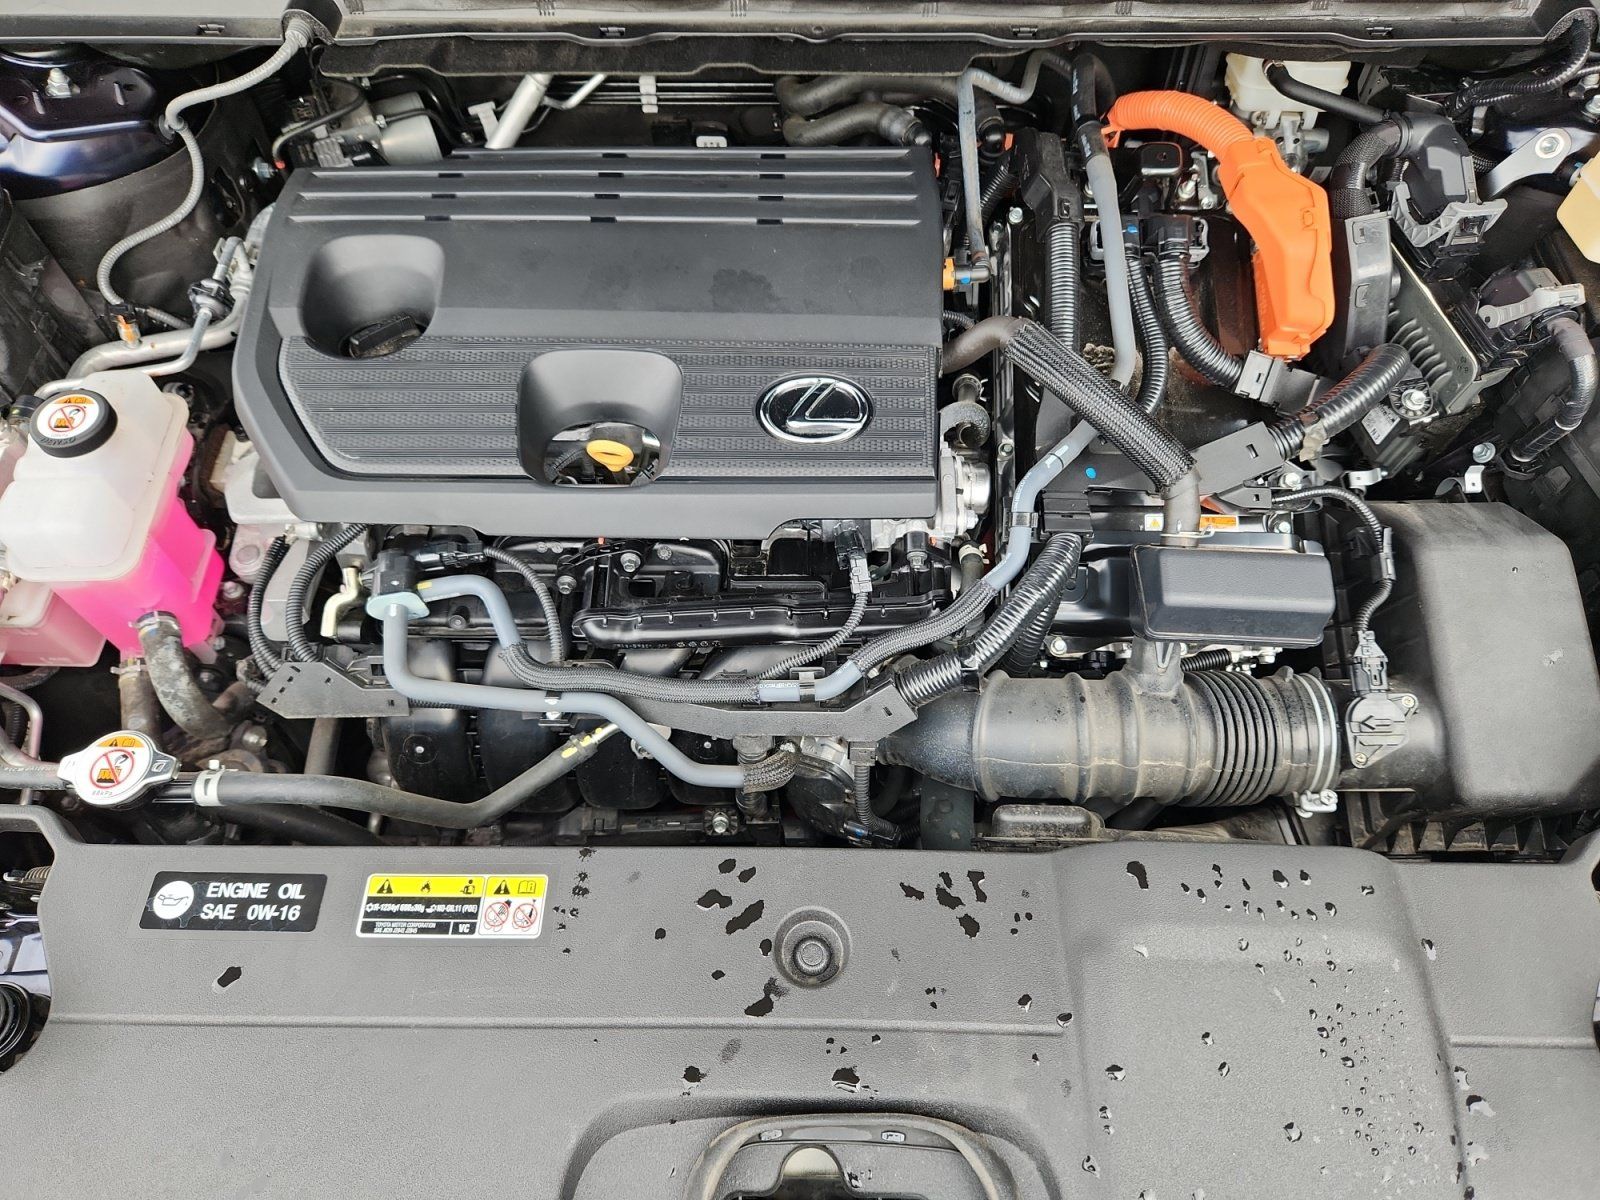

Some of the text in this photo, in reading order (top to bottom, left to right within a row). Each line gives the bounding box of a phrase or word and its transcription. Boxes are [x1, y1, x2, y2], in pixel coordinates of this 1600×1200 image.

[206, 882, 306, 900] ENGINE OIL
[200, 903, 301, 921] SAE 0W-16
[459, 923, 470, 933] VC
